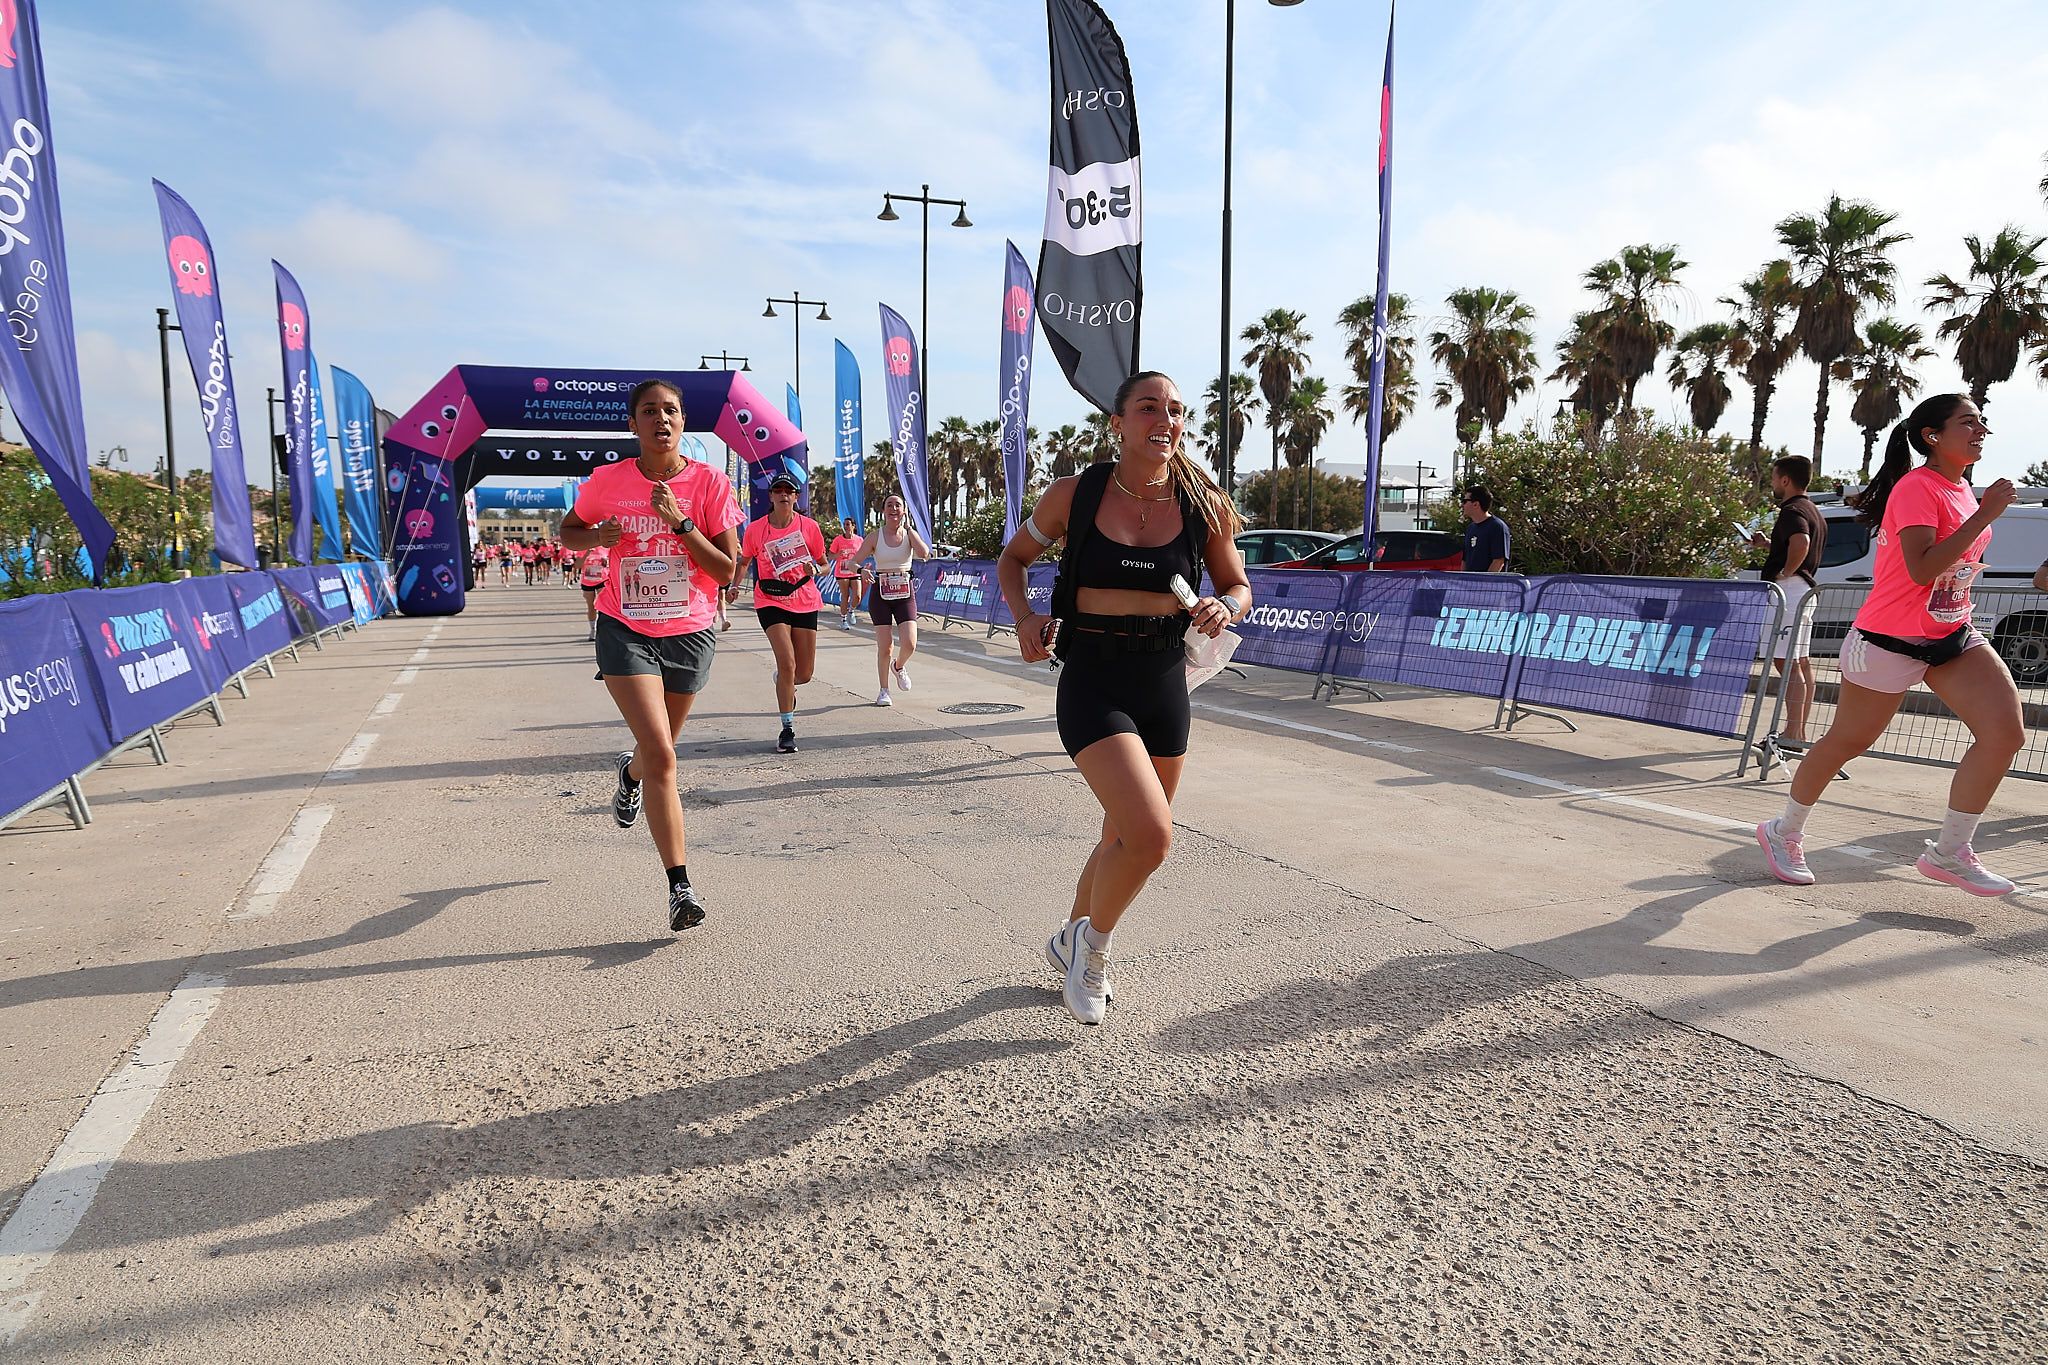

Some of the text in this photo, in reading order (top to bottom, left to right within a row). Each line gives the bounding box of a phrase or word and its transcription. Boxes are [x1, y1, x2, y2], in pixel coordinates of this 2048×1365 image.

[554, 379, 617, 394] octopus
[525, 398, 627, 411] LA ENERGÍA PARA
[523, 411, 532, 419] A
[535, 412, 550, 420] LA
[553, 412, 619, 421] VELOCIDAD
[496, 448, 620, 461] VOLVO
[618, 500, 647, 508] OYSHO
[396, 543, 425, 551] octopus
[1121, 559, 1155, 570] OYSHO
[641, 584, 668, 596] 016
[1951, 589, 1966, 601] 016
[1242, 604, 1380, 643] octopus energy
[1431, 605, 1716, 678] ¡ENHORABUENA!
[24, 656, 81, 707] energy
